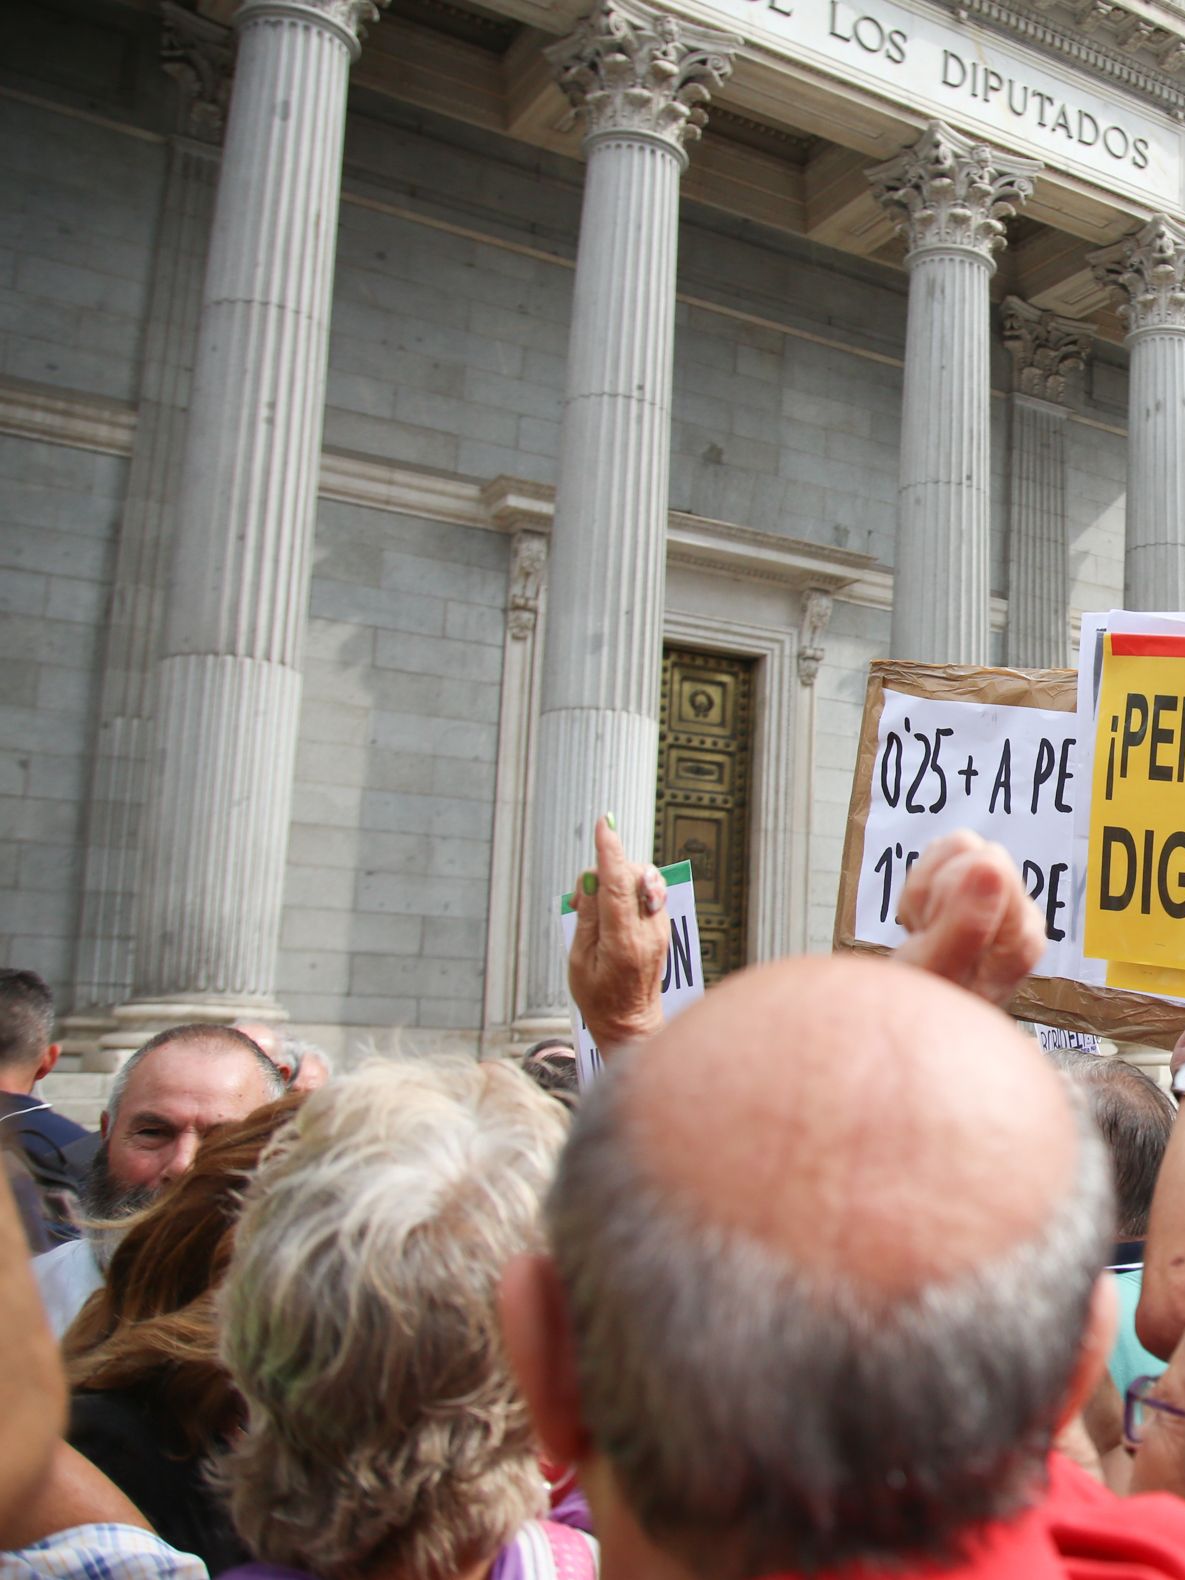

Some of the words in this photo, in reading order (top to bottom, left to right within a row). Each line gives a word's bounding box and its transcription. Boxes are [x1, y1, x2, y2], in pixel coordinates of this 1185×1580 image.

[829, 0, 908, 64] LOS
[941, 49, 1150, 170] DIPUTADOS
[988, 738, 1012, 815] A
